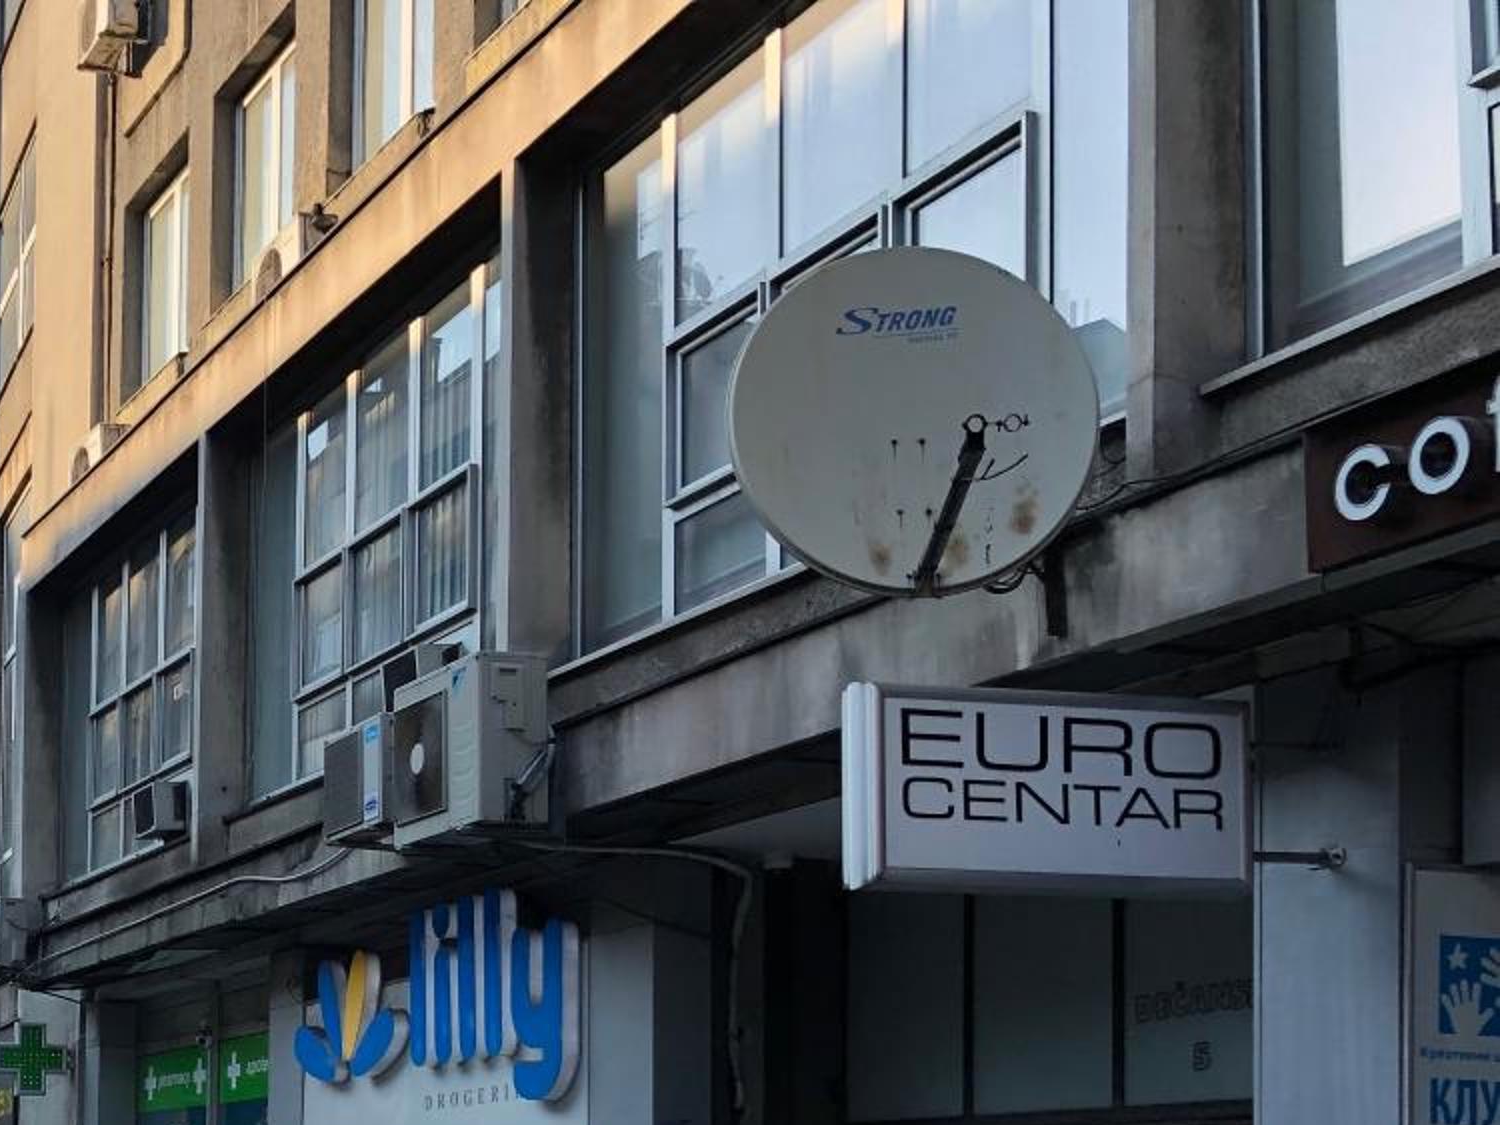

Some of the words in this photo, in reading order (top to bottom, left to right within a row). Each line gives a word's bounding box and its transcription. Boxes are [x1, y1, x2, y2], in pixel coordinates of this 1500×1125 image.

[835, 305, 957, 336] STRONG
[900, 708, 1223, 781] EURO
[901, 776, 1224, 831] CENTAR
[409, 887, 579, 1101] lilly
[1192, 1041, 1213, 1073] 5
[424, 1081, 518, 1112] DROGERI
